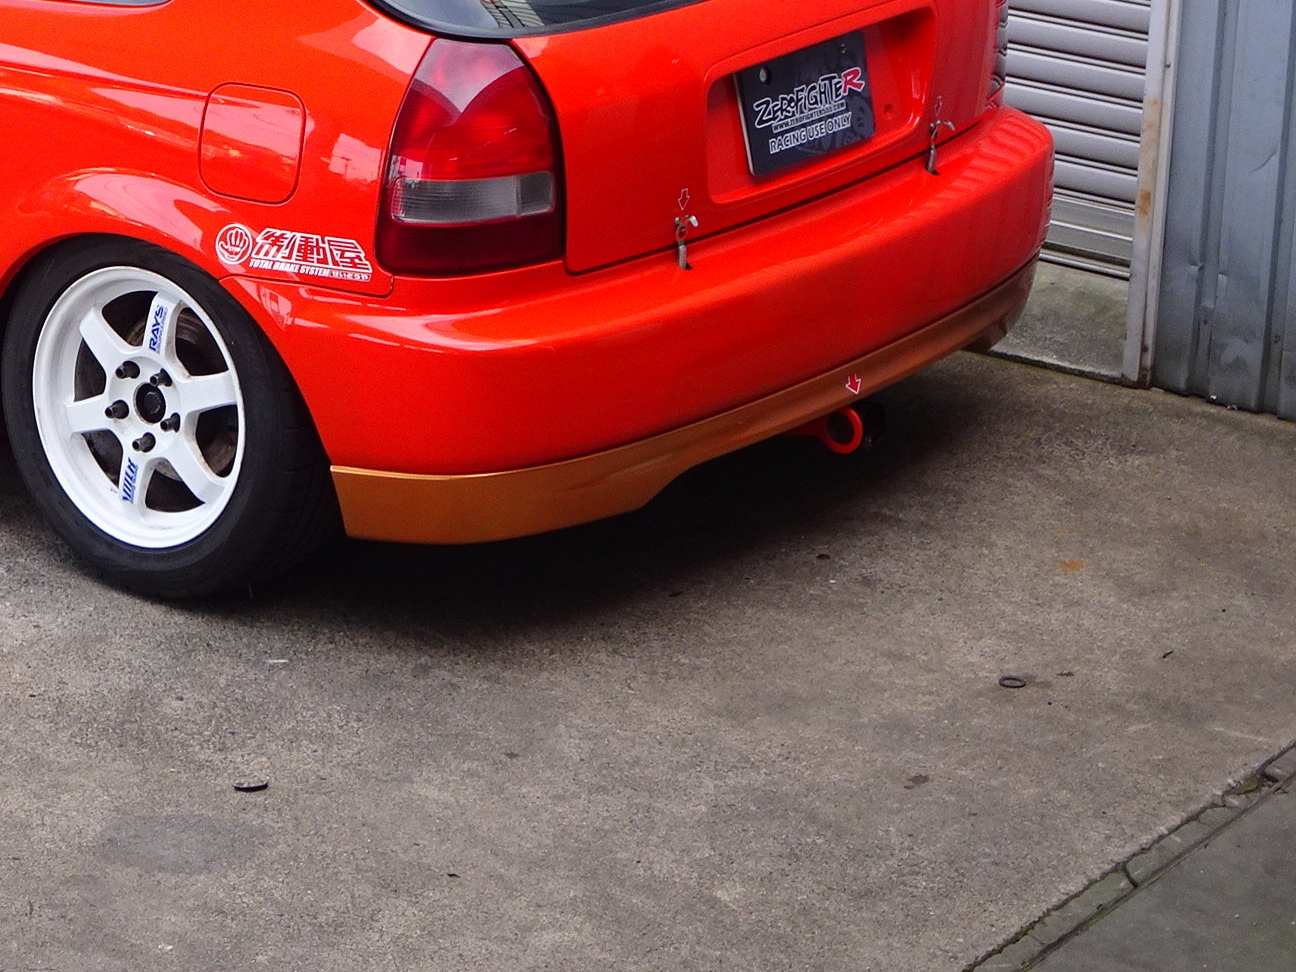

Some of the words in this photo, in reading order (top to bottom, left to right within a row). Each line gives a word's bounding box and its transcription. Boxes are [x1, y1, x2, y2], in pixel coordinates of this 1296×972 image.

[769, 129, 806, 154] RACING
[807, 121, 826, 140] USE
[826, 112, 852, 134] ONLY
[249, 259, 272, 270] TOTAL
[273, 262, 299, 273] BRAKE
[300, 265, 330, 277] SYSTEM
[149, 306, 164, 351] RAYS
